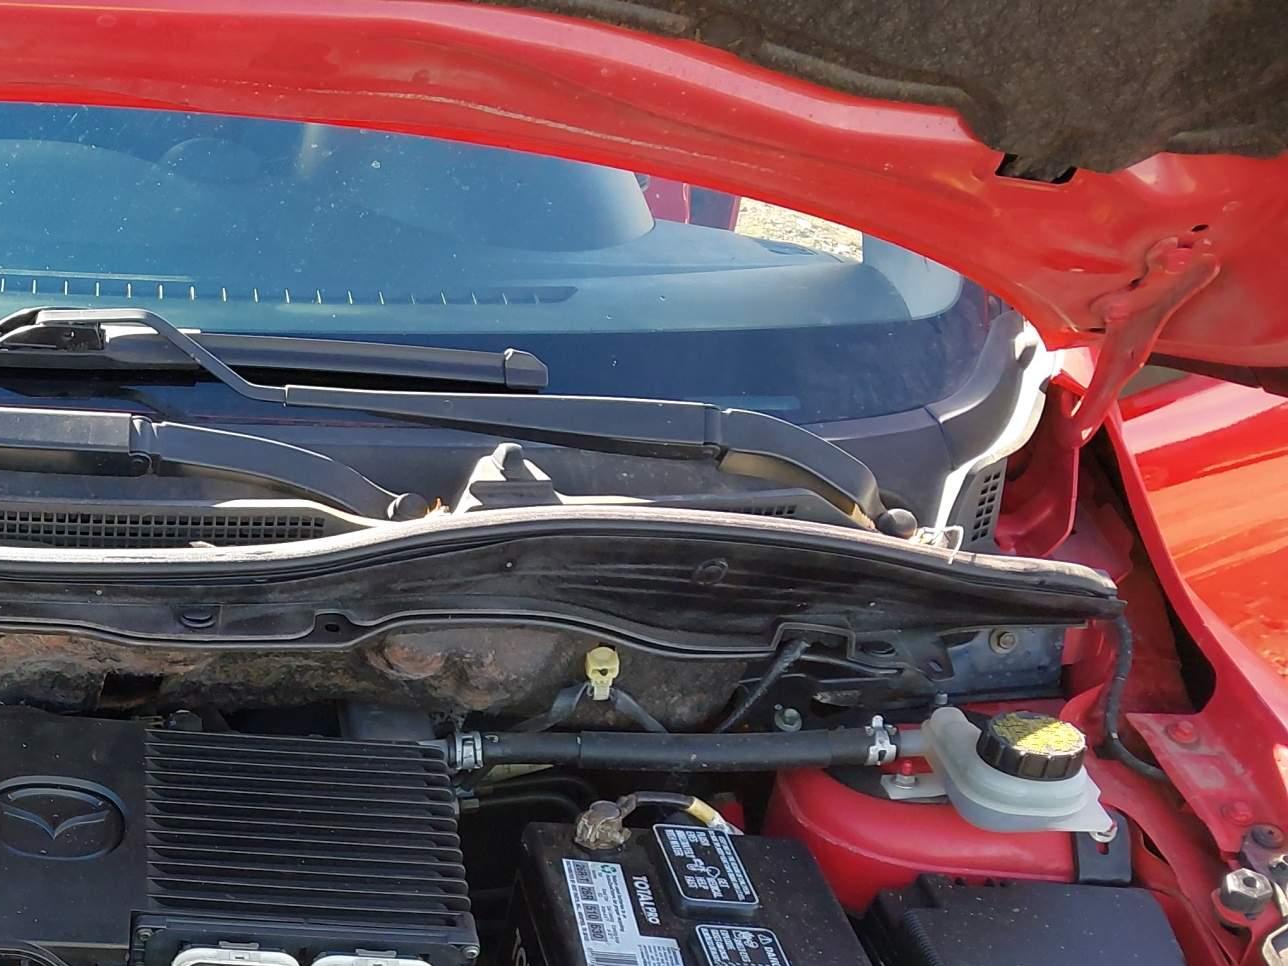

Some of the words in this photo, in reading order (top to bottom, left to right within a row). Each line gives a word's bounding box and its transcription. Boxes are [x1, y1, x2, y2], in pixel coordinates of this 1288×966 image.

[580, 887, 594, 901] 26R
[584, 905, 599, 920] 510
[589, 924, 604, 939] 630
